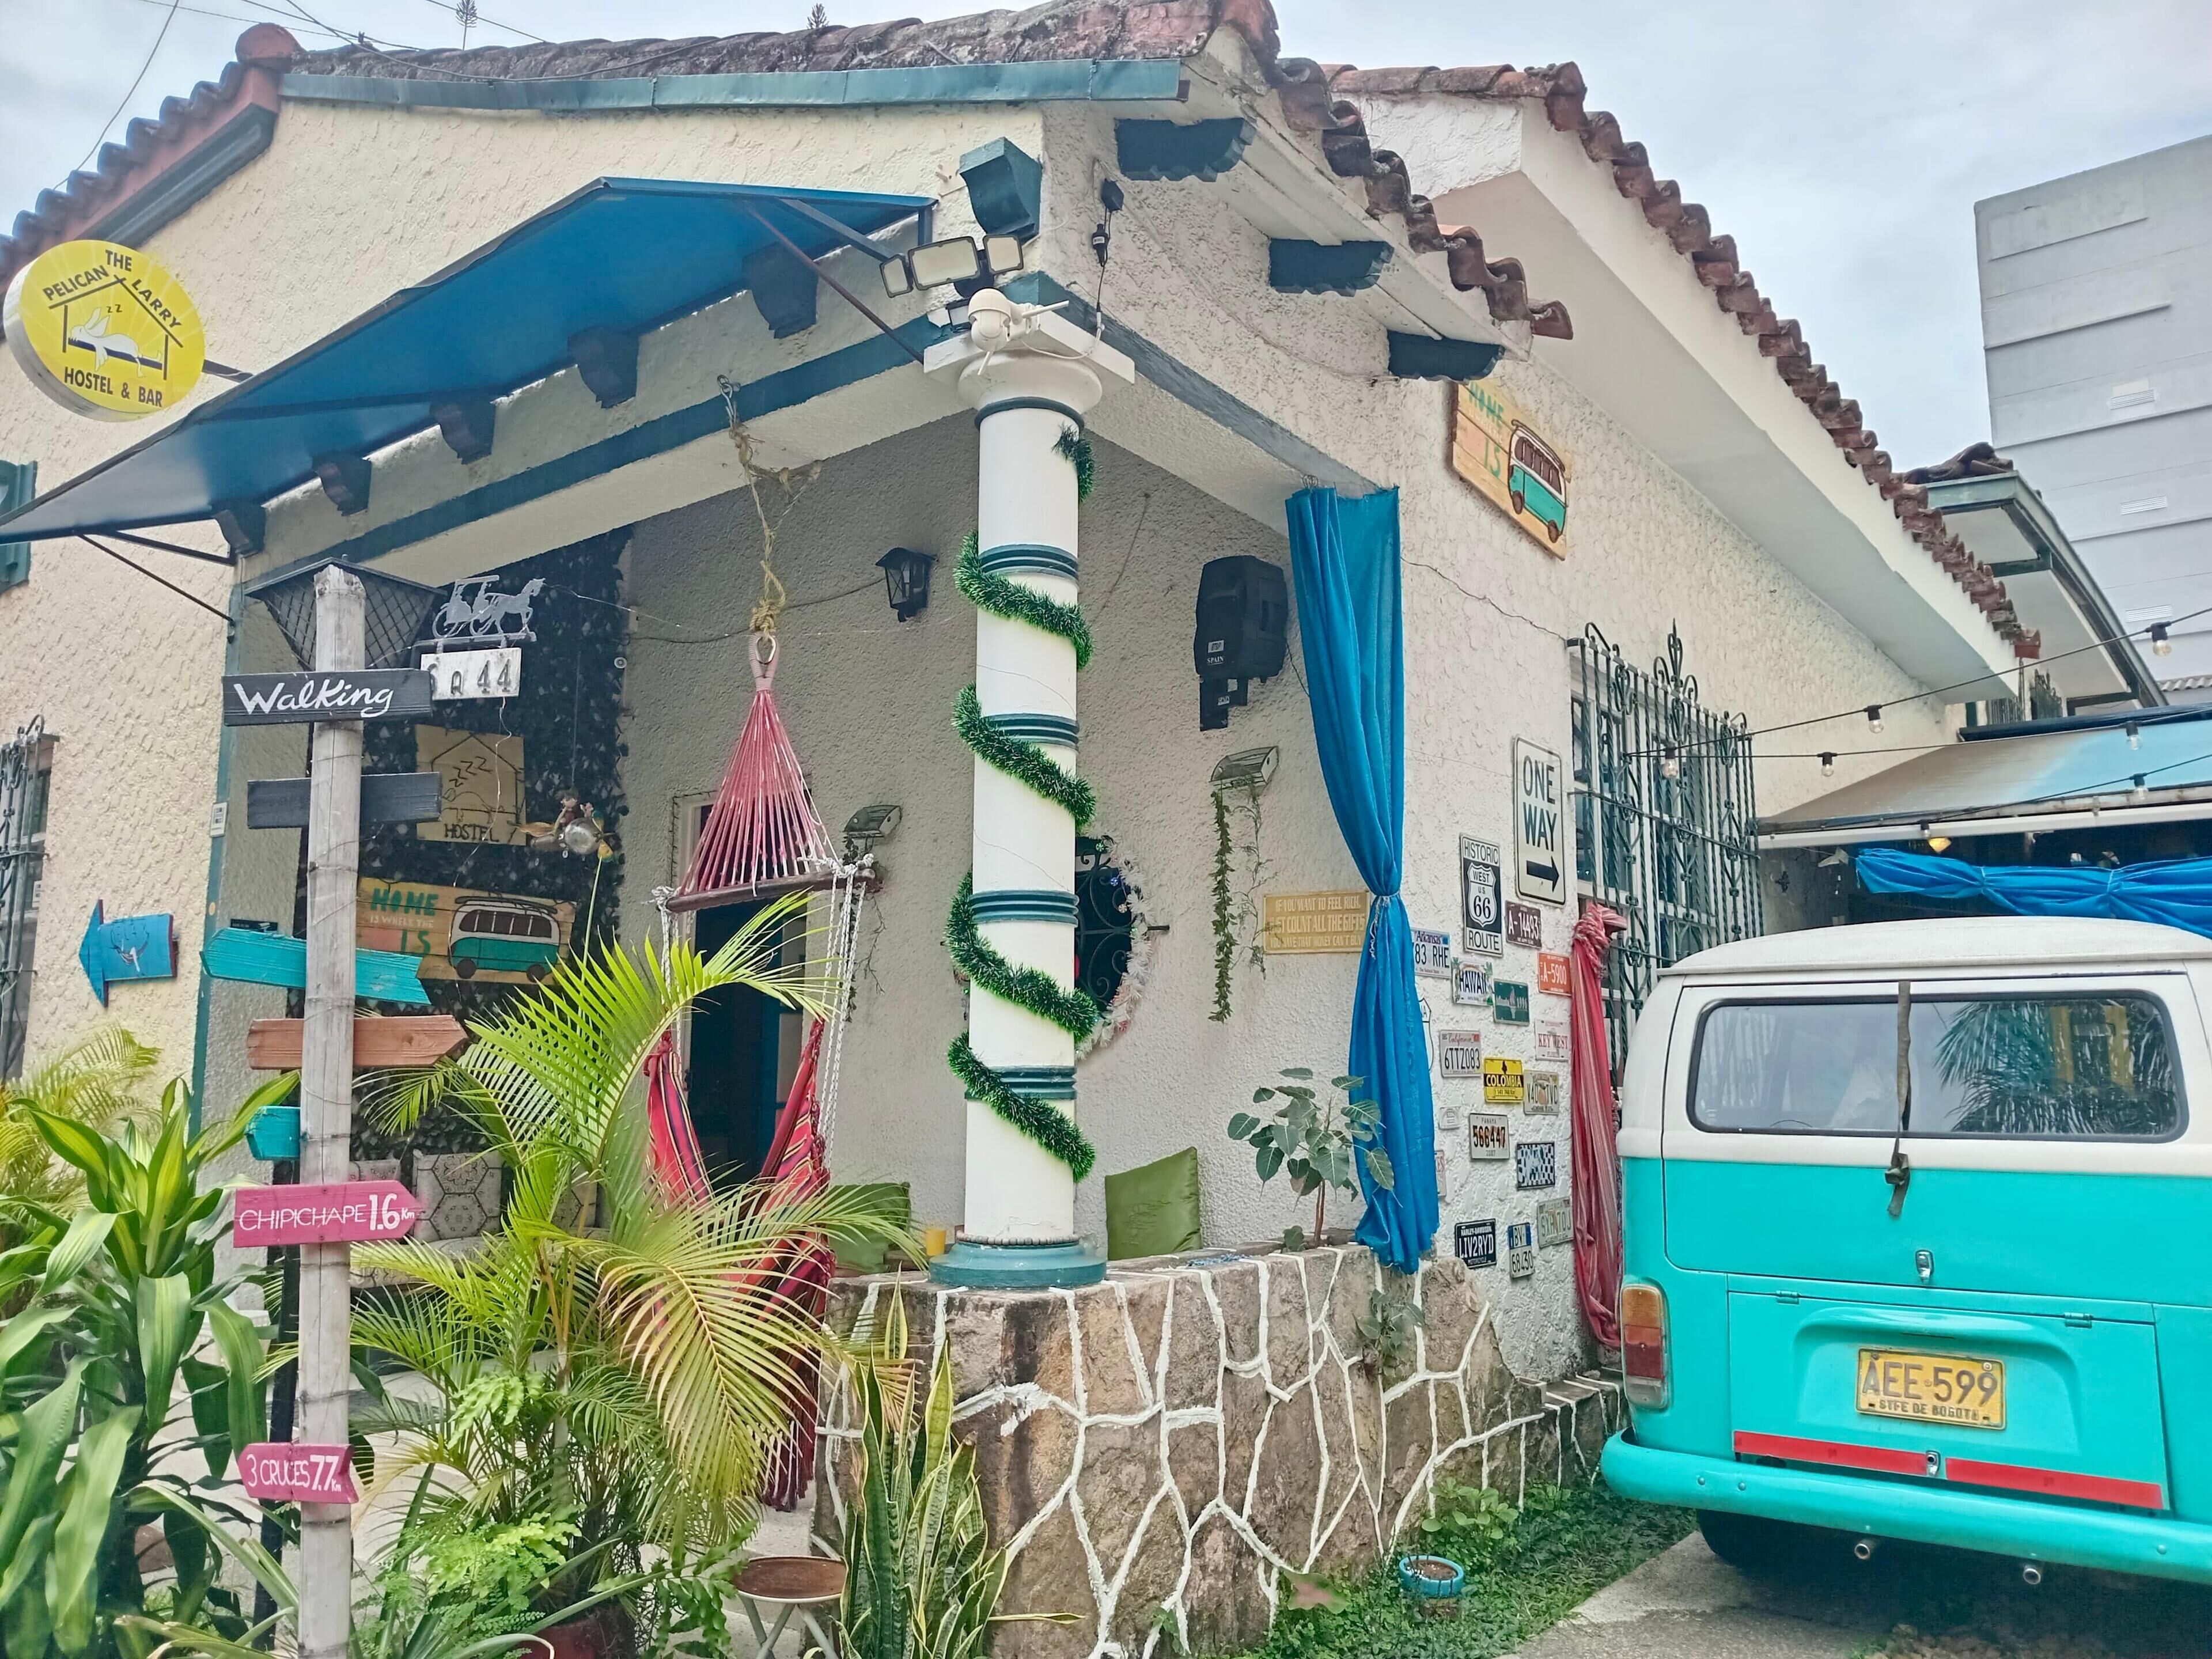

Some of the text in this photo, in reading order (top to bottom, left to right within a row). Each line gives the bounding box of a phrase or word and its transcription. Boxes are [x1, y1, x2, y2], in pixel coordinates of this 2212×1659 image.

[105, 249, 132, 271] THE
[43, 265, 109, 301] PELICAN
[131, 279, 181, 328] LARRY
[64, 366, 162, 407] HOSTEL & BAR
[477, 658, 512, 694] 44
[1523, 755, 1556, 805] ONE
[444, 824, 499, 842] HOSTEL
[1523, 802, 1557, 851] WAY
[1464, 840, 1498, 864] HISTORIC
[1473, 870, 1490, 884] WEST
[370, 888, 439, 916] HOME
[1327, 896, 1343, 910] FEEL
[1474, 895, 1491, 919] 66
[1312, 915, 1327, 933] ALL
[1327, 914, 1343, 931] THE
[1343, 913, 1365, 931] GIFTS
[1508, 910, 1539, 940] A-14493
[1416, 931, 1441, 945] Arkansas
[1469, 930, 1499, 950] ROUTE
[1412, 942, 1450, 968] 83 RHE
[1544, 961, 1567, 985] A-5900
[1538, 1033, 1550, 1048] KEY
[1444, 1047, 1480, 1070] 6TTZ083
[1486, 1074, 1522, 1088] COLOMBIA
[1472, 1125, 1505, 1149] 566447
[238, 1203, 367, 1231] CHIPICHAPE
[368, 1193, 400, 1231] 1.6
[1459, 1234, 1494, 1259] LIV2RYD
[1912, 1403, 1927, 1415] DE
[1931, 1406, 1980, 1421] BOGOTA
[246, 1454, 257, 1488] 3
[259, 1460, 310, 1488] CRUCES
[309, 1455, 339, 1491] 7.7
